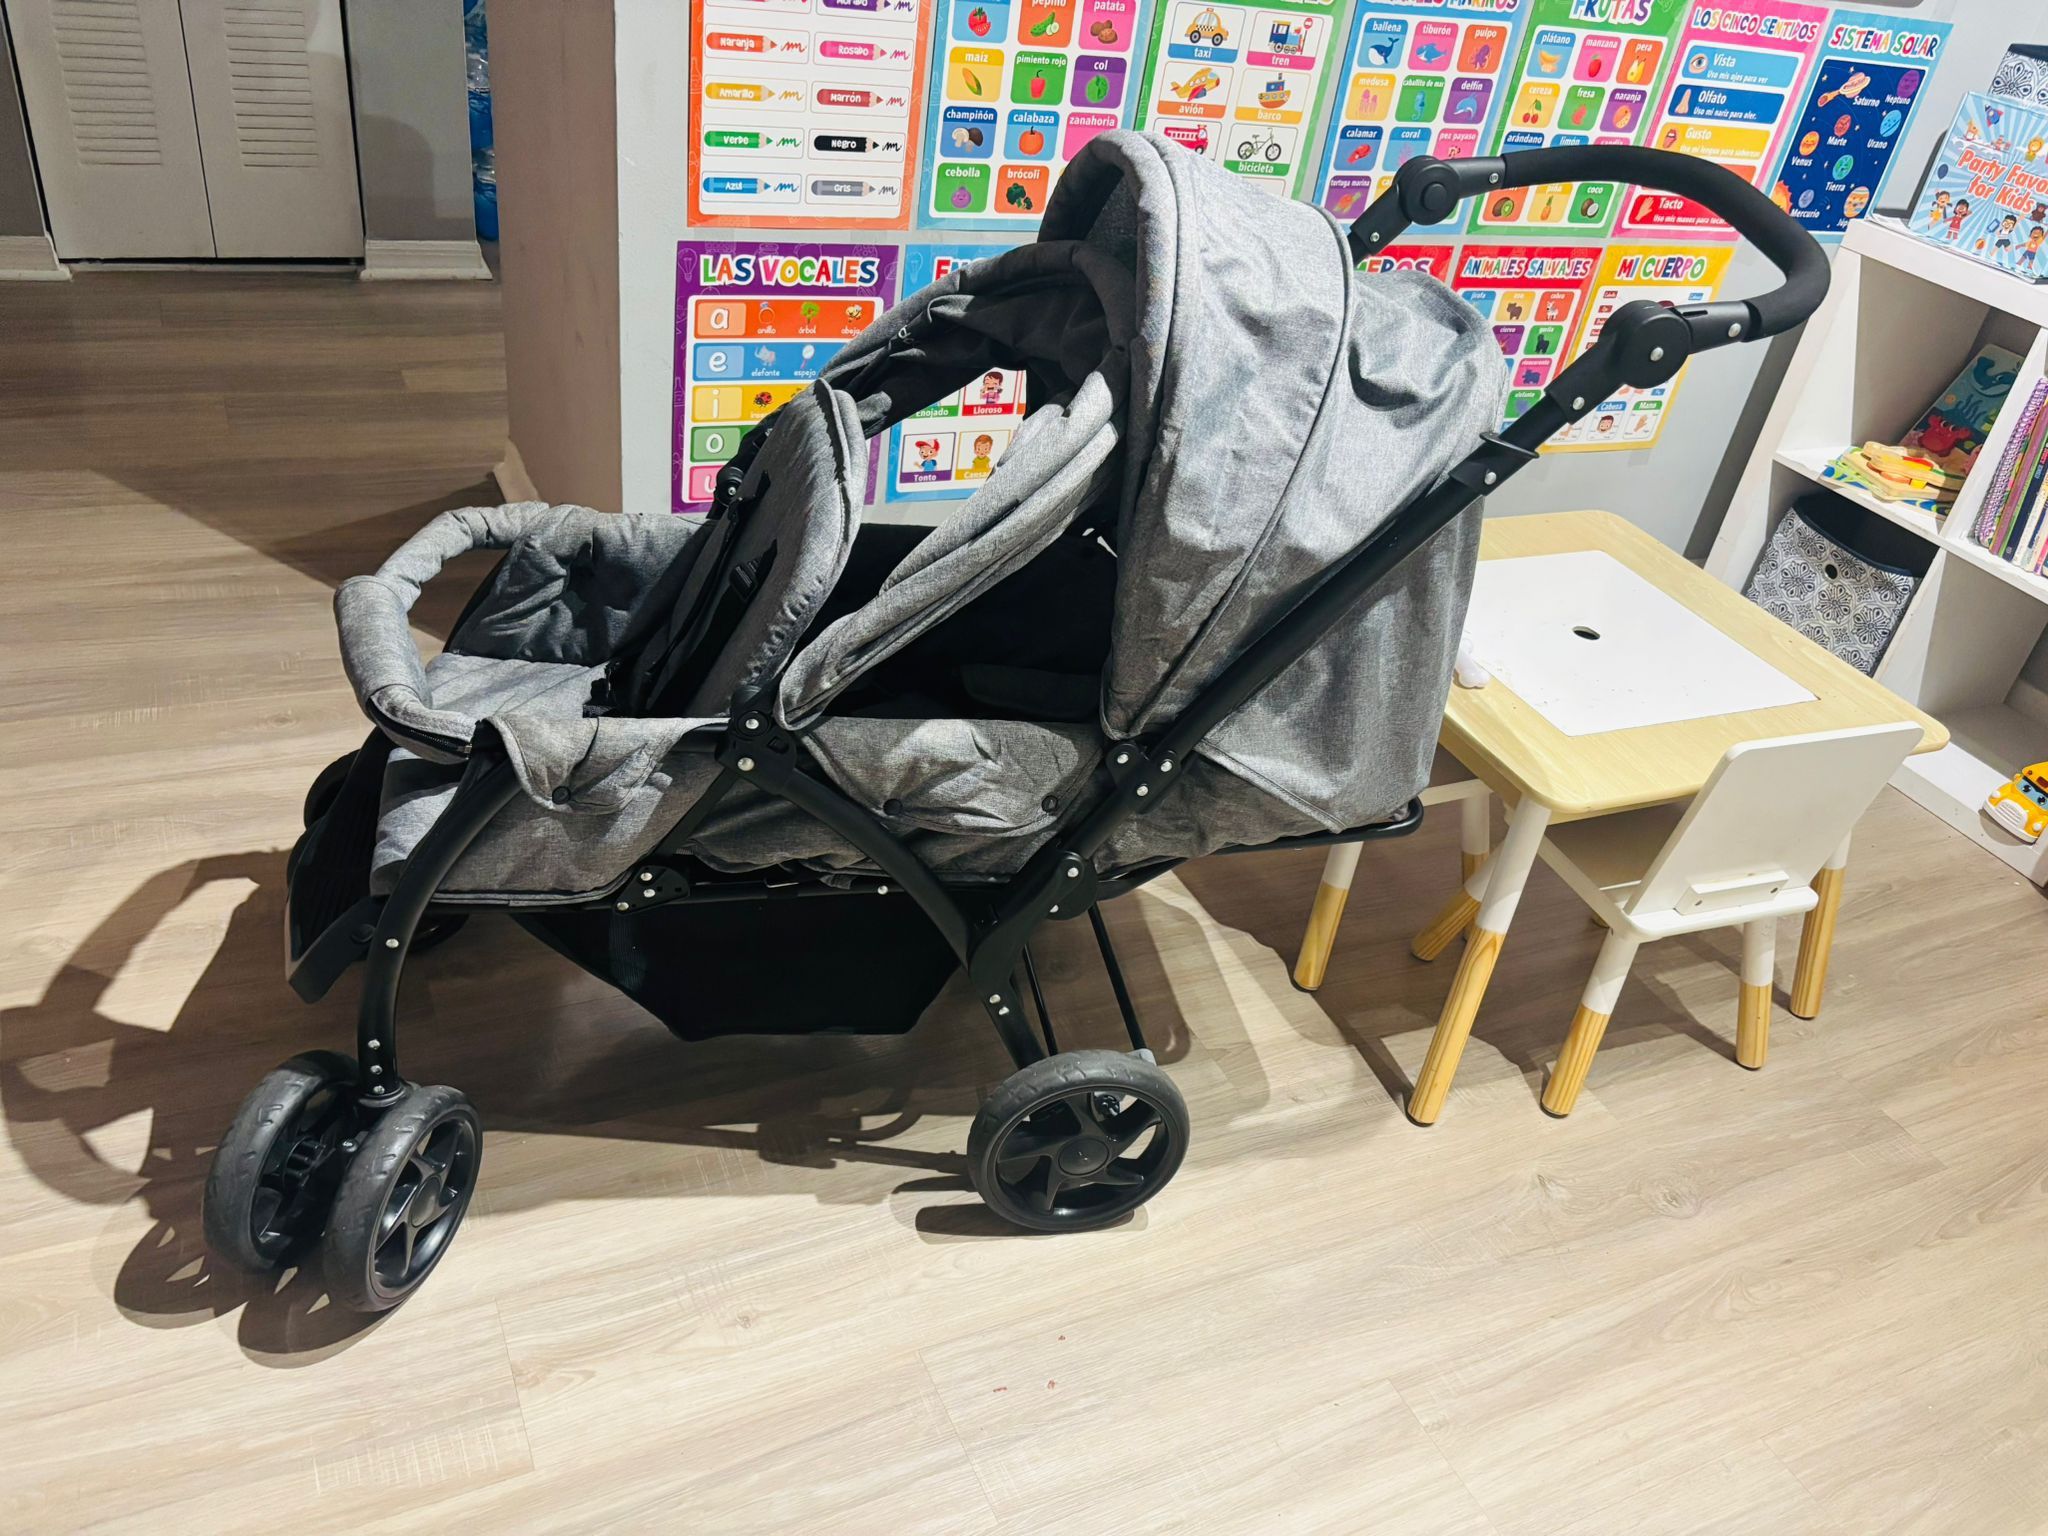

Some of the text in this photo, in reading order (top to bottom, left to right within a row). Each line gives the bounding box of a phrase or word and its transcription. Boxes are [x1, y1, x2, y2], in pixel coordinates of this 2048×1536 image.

[1094, 0, 1126, 12] patata
[1573, 0, 1650, 22] FRUTAS
[1372, 23, 1402, 32] ballena
[1693, 8, 1818, 40] LOS CINCO SENTIDOS
[1422, 24, 1452, 36] tiburón
[1474, 28, 1497, 38] pulpo
[720, 37, 755, 50] Naranja
[1541, 33, 1570, 44] plátano
[1586, 38, 1618, 49] manzana
[1831, 26, 1938, 58] SISTEMA SOLAR
[1194, 49, 1212, 59] taxi
[1636, 44, 1652, 53] pera
[1016, 55, 1066, 66] pimiento rojo
[1094, 60, 1108, 71] col
[1272, 56, 1290, 66] tren
[1713, 53, 1736, 68] Vista
[1707, 70, 1718, 78] Uso
[1359, 77, 1389, 86] medusa
[1460, 80, 1483, 90] delfín
[720, 88, 754, 98] Amarillo
[1528, 86, 1553, 95] cereza
[1576, 88, 1595, 98] fresa
[830, 90, 862, 104] Marrón
[1614, 91, 1642, 102] naranja
[1698, 90, 1728, 104] Olfato
[1852, 96, 1880, 108] Saturno
[1884, 94, 1912, 106] Neptuno
[1178, 104, 1204, 115] avión
[1694, 106, 1706, 115] Uso
[946, 110, 994, 122] champiñón
[1013, 113, 1055, 124] calabaza
[1070, 115, 1115, 127] zanahoria
[1258, 111, 1282, 121] barco
[1346, 129, 1378, 138] calamar
[1401, 129, 1420, 138] coral
[1506, 134, 1542, 144] arándano
[1686, 128, 1712, 140] Gusto
[832, 138, 856, 150] Negro
[1560, 136, 1580, 145] limón
[1827, 136, 1848, 146] Marte
[1867, 139, 1888, 150] Urano
[1792, 156, 1813, 166] Venus
[1958, 149, 2007, 183] Party
[945, 168, 980, 178] cebolla
[1238, 162, 1274, 174] bicicleta
[1007, 168, 1040, 180] brócoli
[724, 182, 743, 191] Azul
[834, 182, 852, 193] Gris
[1826, 182, 1846, 192] Tierra
[1968, 175, 2035, 214] for Kids
[1658, 197, 1684, 210] Tacto
[1790, 209, 1820, 218] Mercurio
[702, 257, 877, 285] LAS VOCALES
[1463, 258, 1590, 278] ANIMALES SALVAJES
[1618, 257, 1706, 280] MI CUERPO
[710, 308, 730, 330] a
[756, 326, 776, 334] anillo
[798, 326, 816, 334] árbol
[708, 351, 817, 378] e elefante espejo
[712, 388, 720, 418] i
[916, 408, 949, 418] Enojado
[973, 406, 1002, 414] Lloroso
[706, 433, 724, 453] o
